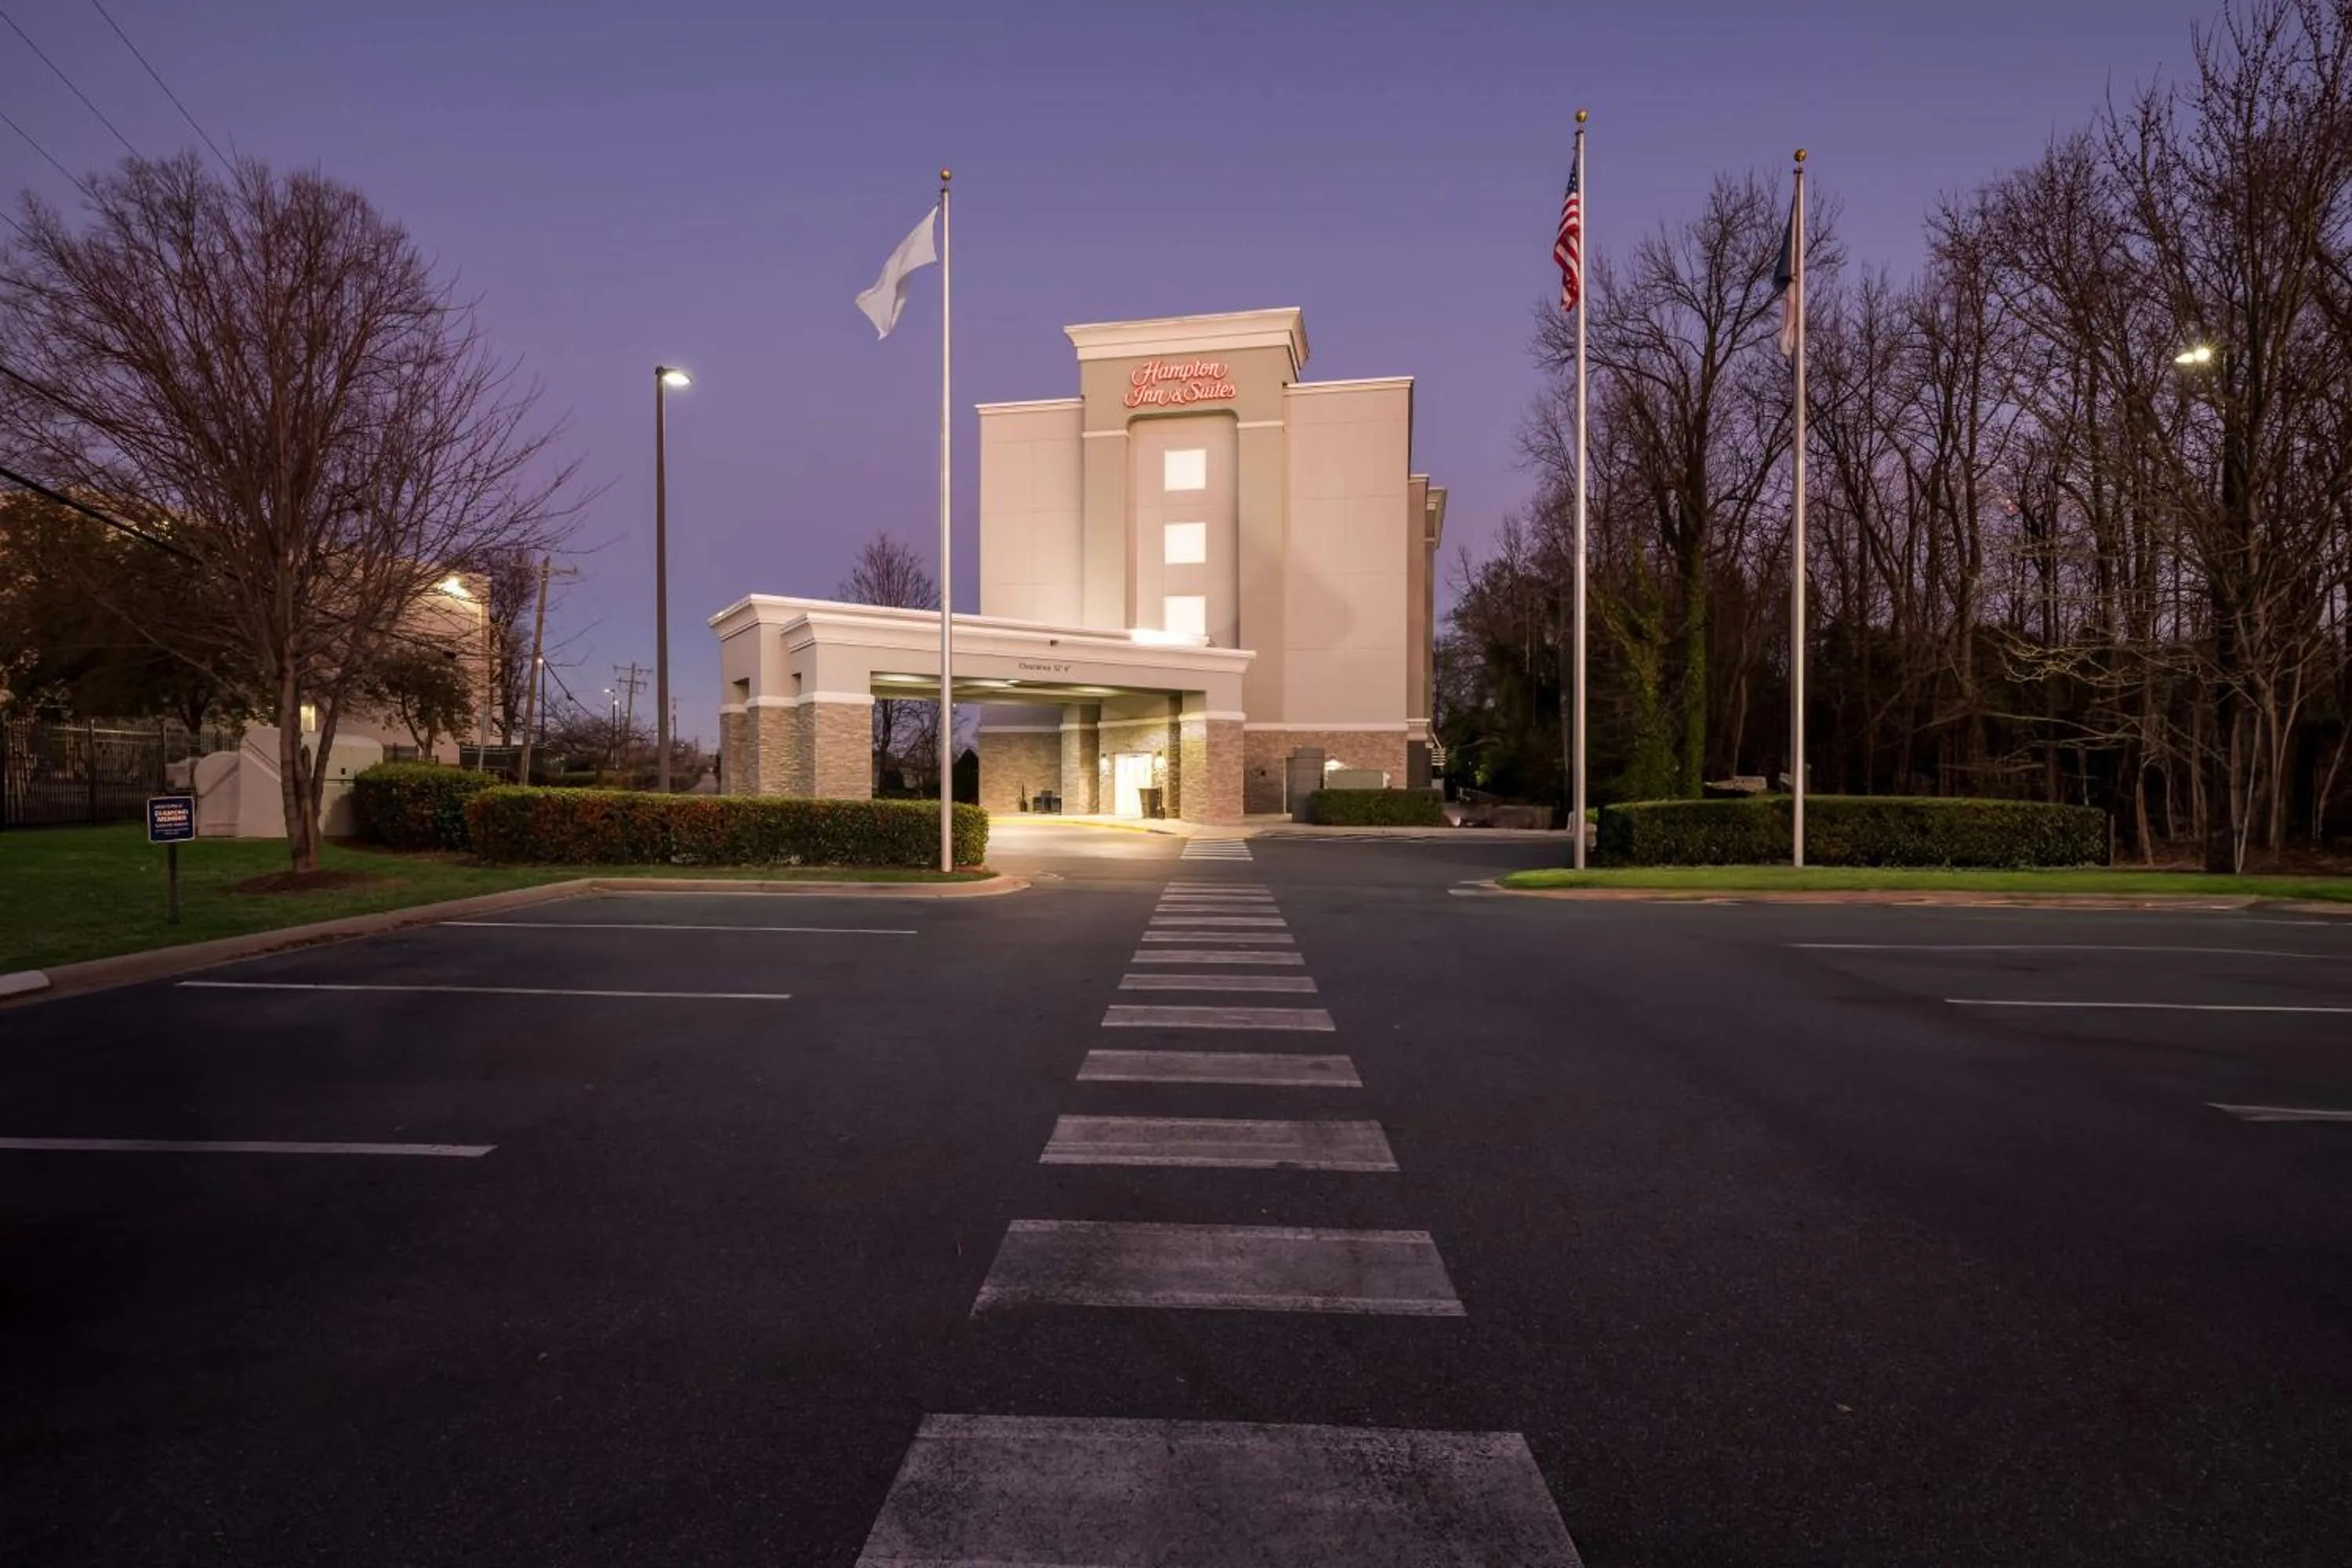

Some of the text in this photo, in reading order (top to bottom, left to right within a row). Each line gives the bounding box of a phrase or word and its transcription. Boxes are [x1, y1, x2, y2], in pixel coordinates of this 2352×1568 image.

[1131, 360, 1229, 387] Hampton
[1124, 381, 1237, 408] Inn & Suites
